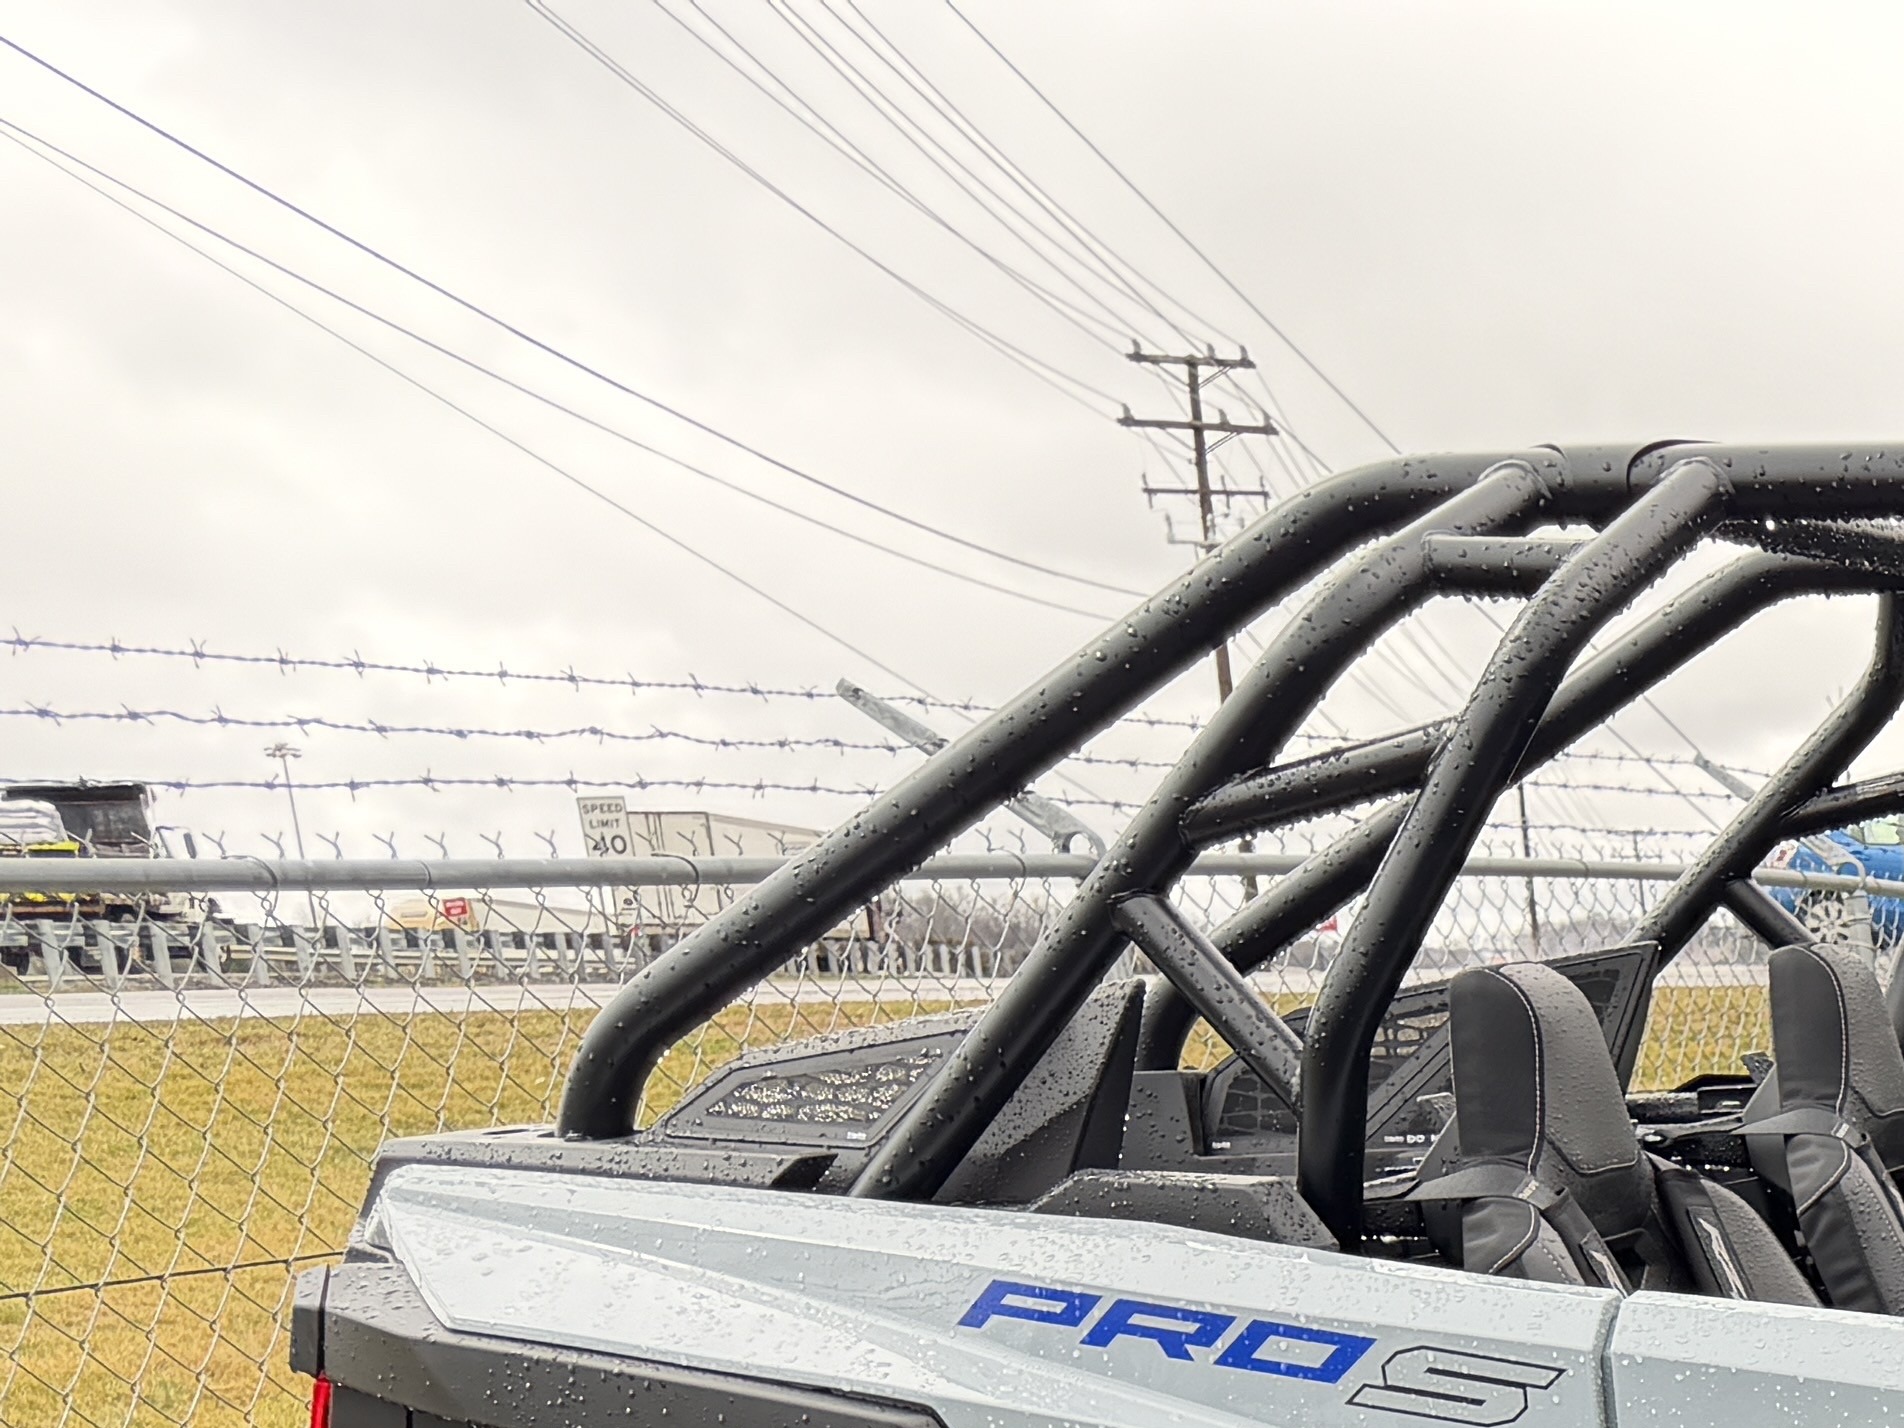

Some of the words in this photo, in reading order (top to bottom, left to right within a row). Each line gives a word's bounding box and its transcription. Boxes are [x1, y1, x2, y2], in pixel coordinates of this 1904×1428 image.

[582, 802, 623, 815] SPEED
[589, 818, 619, 829] LIMIT
[592, 832, 627, 855] 40
[957, 1278, 1378, 1385] PRO
[1345, 1344, 1568, 1428] S
